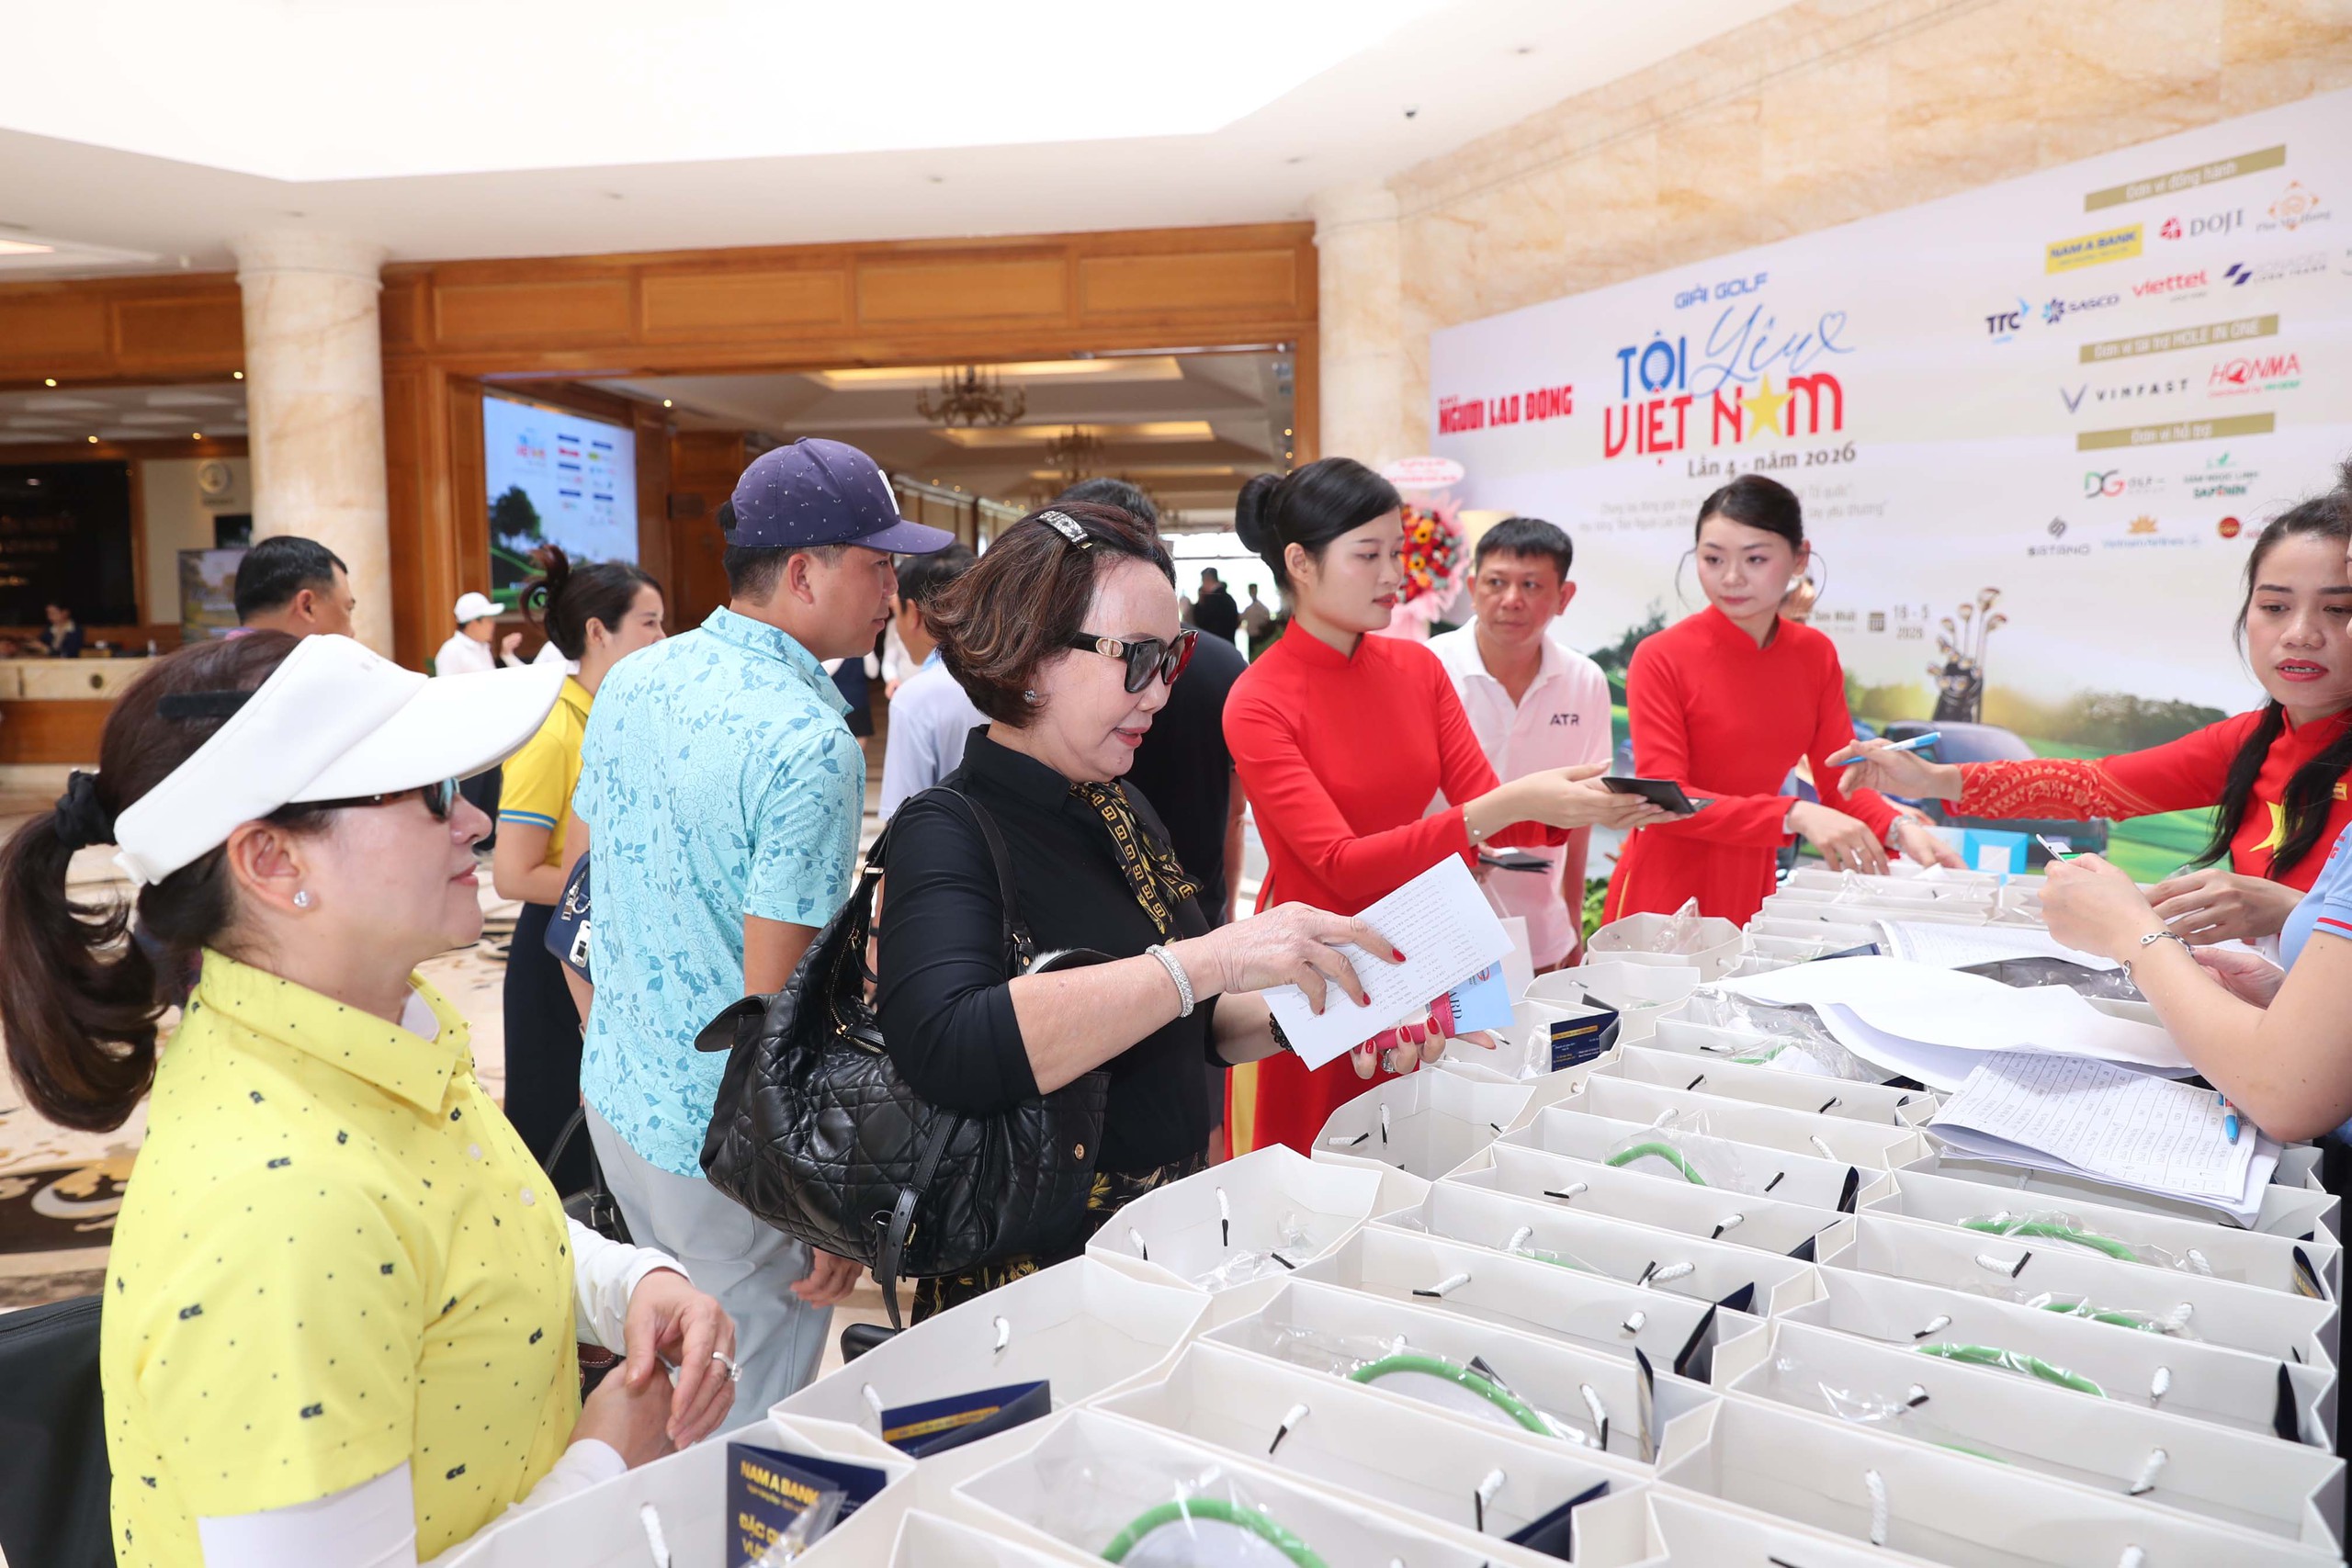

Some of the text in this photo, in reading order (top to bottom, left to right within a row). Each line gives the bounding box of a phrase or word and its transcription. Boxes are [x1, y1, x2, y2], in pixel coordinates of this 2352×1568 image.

[2190, 209, 2244, 236] DOJI
[1714, 272, 1769, 299] GOLF
[2132, 270, 2208, 298] viettel
[1985, 311, 2020, 333] TTC
[2212, 323, 2227, 340] IN
[2230, 320, 2260, 339] ONE
[2208, 353, 2301, 386] HONMA
[2096, 378, 2188, 400] VINFAST
[1490, 394, 1520, 427] LAO
[1604, 388, 1693, 466] VIỆT
[1725, 460, 1736, 479] 4
[1805, 441, 1856, 466] 2026
[1550, 714, 1580, 726] ATR
[741, 1460, 769, 1487] NAM
[769, 1473, 780, 1493] A
[781, 1477, 820, 1506] BANK
